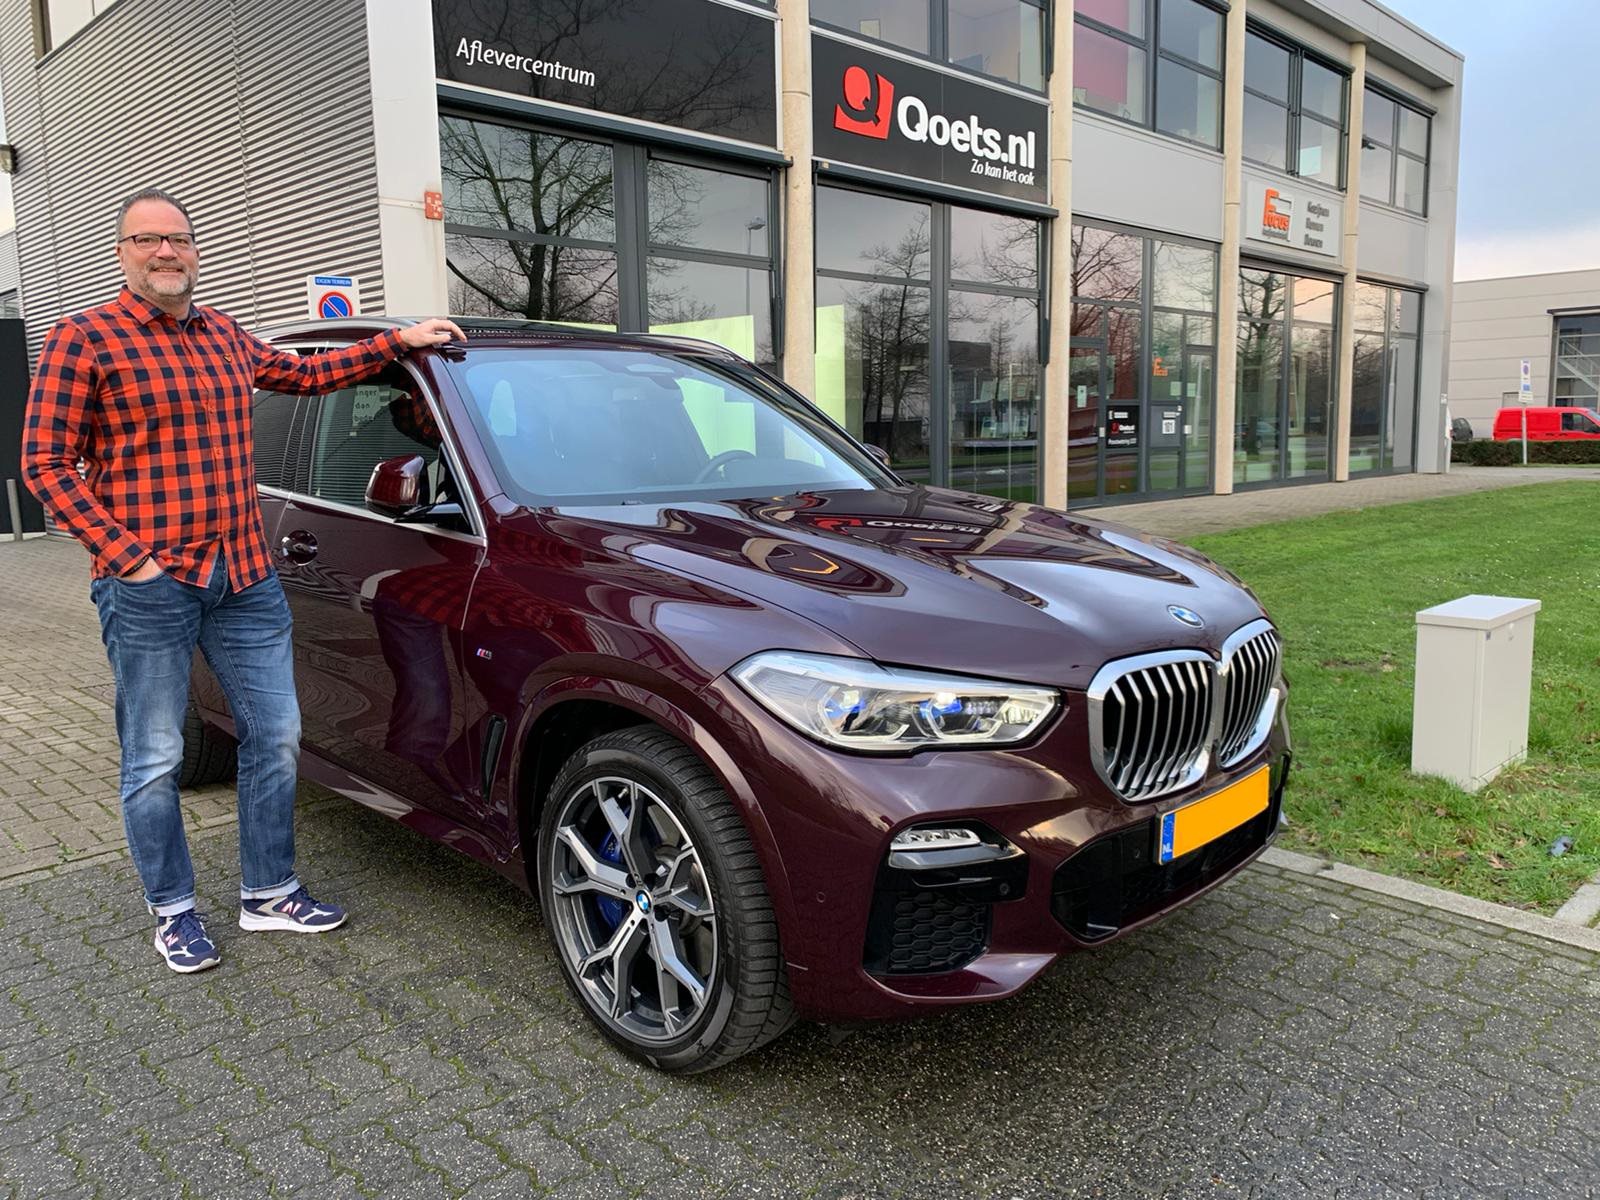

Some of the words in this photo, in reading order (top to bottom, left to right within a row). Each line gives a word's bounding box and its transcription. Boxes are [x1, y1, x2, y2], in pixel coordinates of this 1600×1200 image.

[456, 37, 596, 87] Aflevercentrum
[897, 95, 1035, 169] Qoets.nl
[970, 158, 984, 175] Zo
[984, 161, 1002, 179] kan
[1002, 165, 1018, 183] het
[1018, 171, 1035, 186] ook
